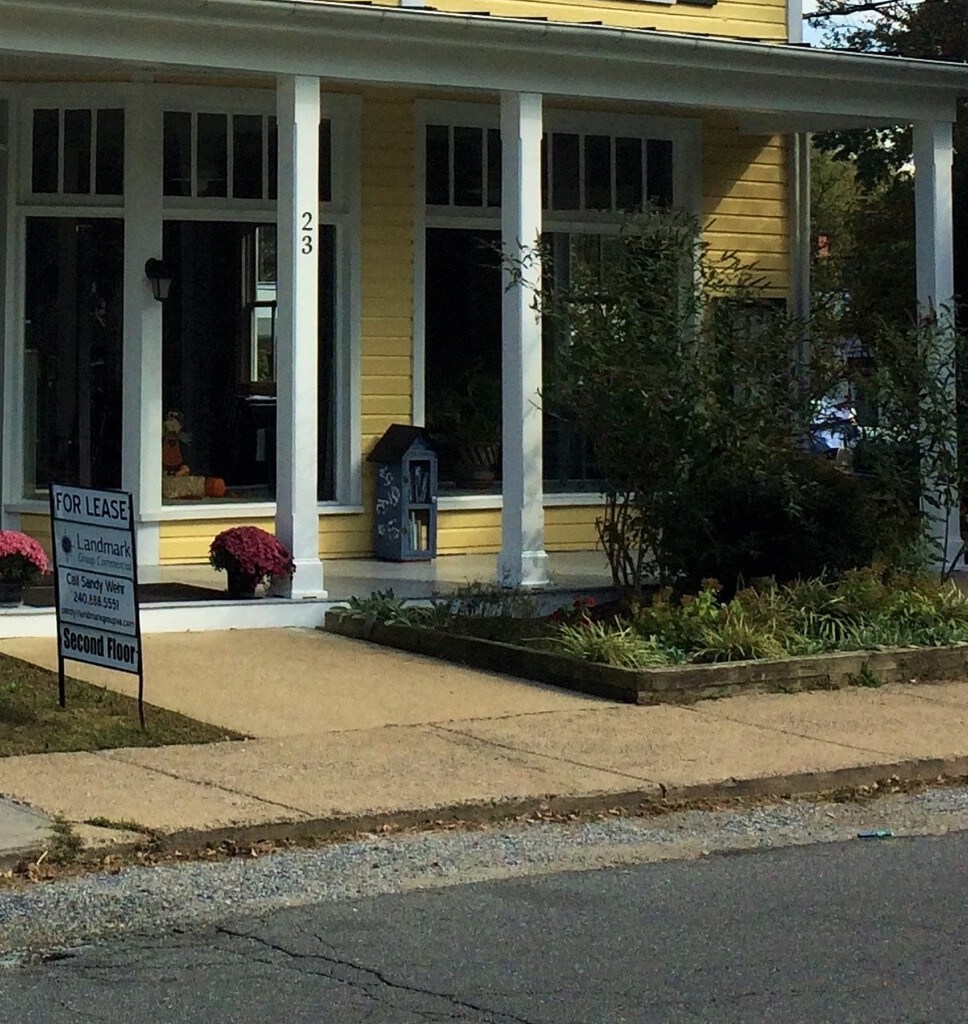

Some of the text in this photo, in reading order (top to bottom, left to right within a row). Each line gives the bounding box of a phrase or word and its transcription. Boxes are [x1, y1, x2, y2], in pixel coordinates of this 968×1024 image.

[301, 211, 313, 255] 23
[56, 492, 128, 521] FOR LEASE
[76, 533, 131, 558] Landmark
[66, 572, 80, 586] Call
[81, 575, 104, 594] Sandy
[63, 627, 136, 664] Second Floor
